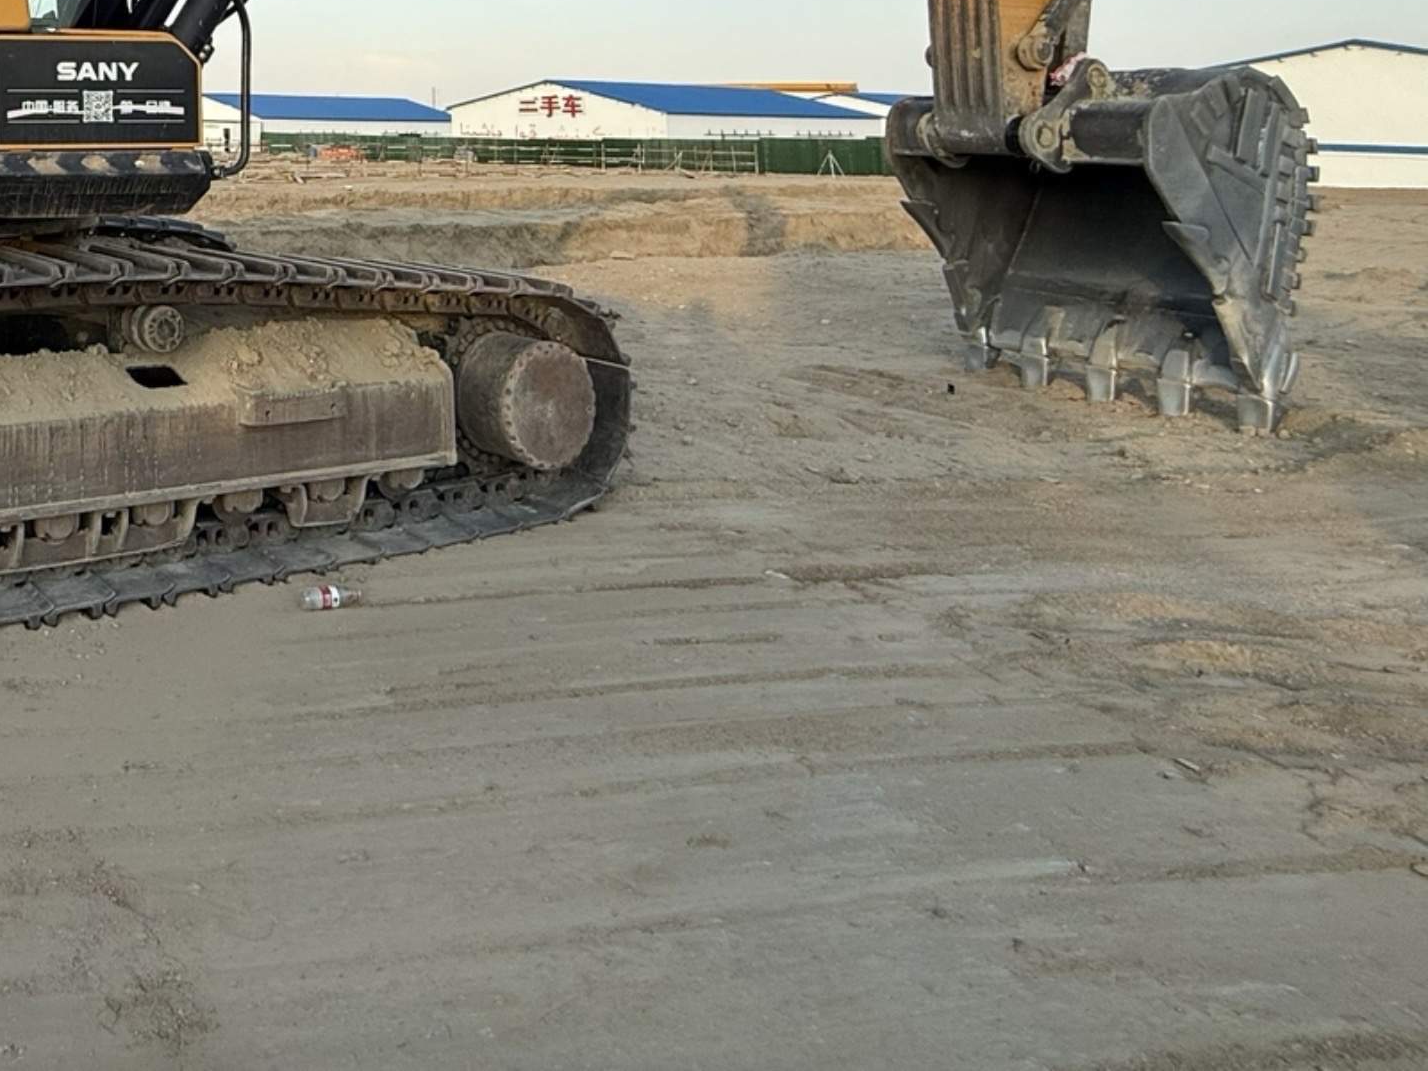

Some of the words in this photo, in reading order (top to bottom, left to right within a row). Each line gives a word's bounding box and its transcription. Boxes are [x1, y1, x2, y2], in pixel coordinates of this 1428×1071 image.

[56, 61, 140, 82] SANY
[518, 94, 583, 118] 二手车
